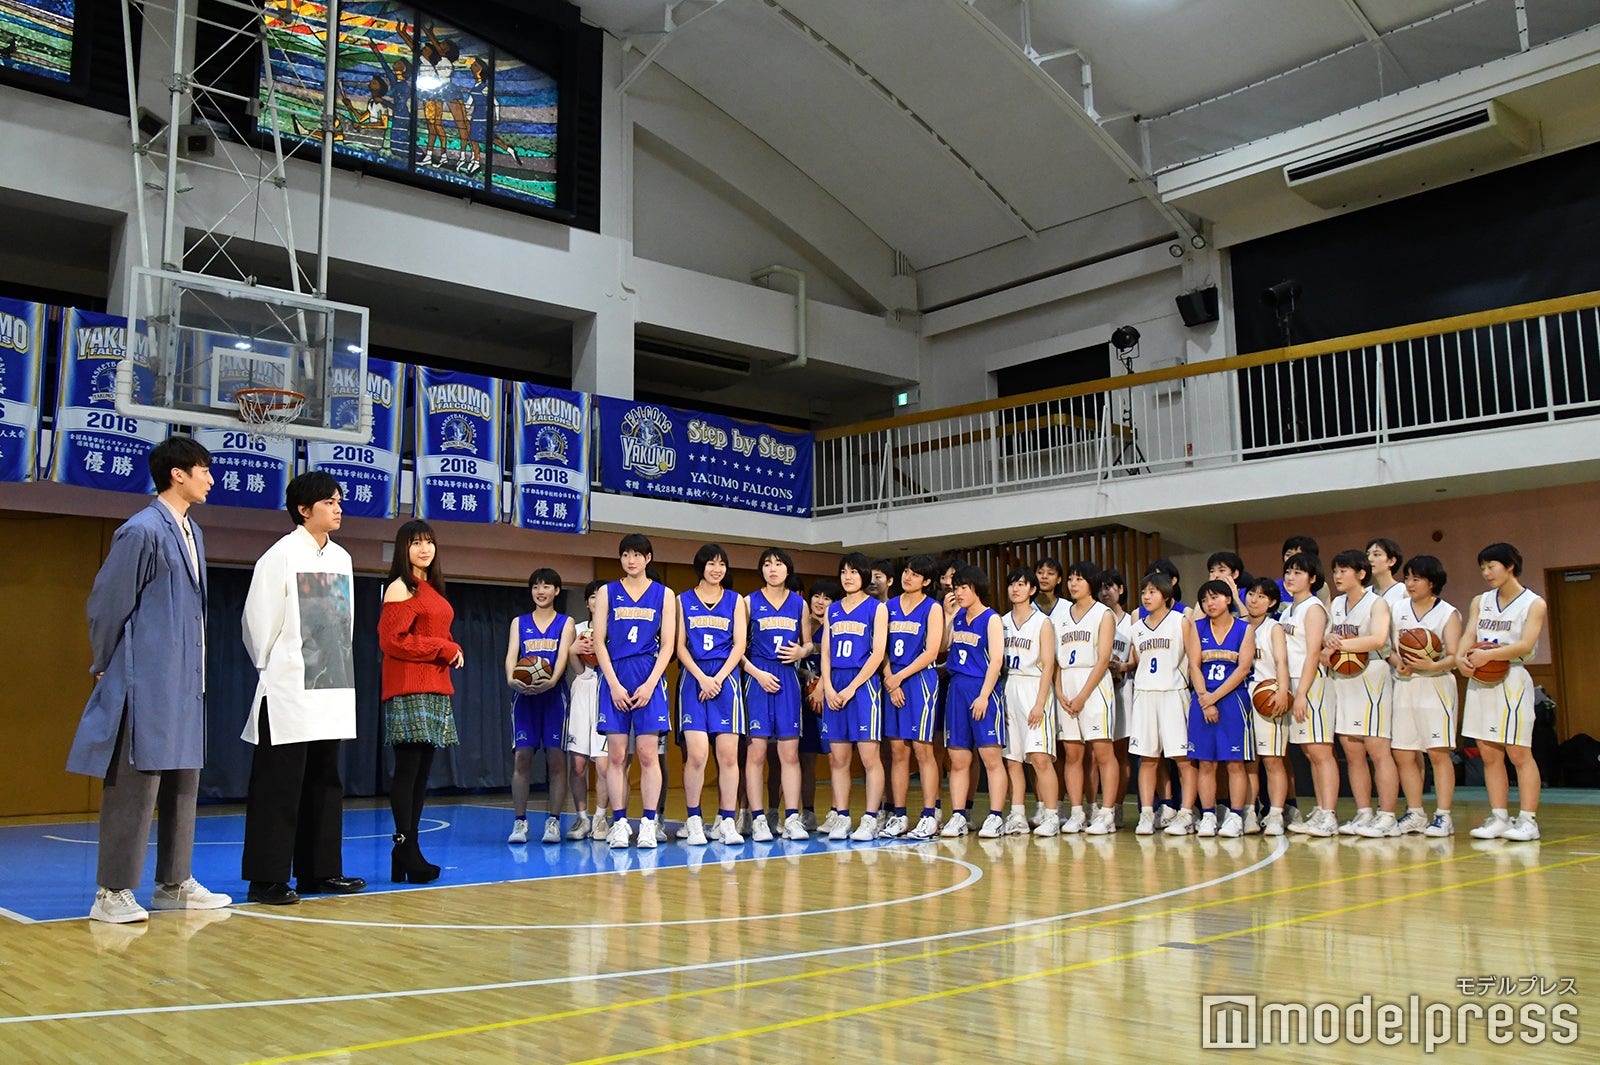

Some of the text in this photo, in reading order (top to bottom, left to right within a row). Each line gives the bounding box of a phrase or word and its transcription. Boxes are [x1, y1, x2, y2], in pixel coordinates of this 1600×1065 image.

[427, 384, 491, 419] YAKUMO
[437, 402, 480, 414] FALCONS
[86, 411, 138, 434] 2016
[524, 397, 581, 431] YAKUMO
[624, 405, 673, 434] FALCONS
[687, 419, 797, 465] Step by Step
[332, 445, 375, 465] 2018
[620, 434, 676, 472] YAKUMO
[82, 450, 135, 477] 優勝
[440, 457, 478, 475] 2018
[221, 470, 267, 494] 優勝
[534, 467, 569, 485] 2018
[742, 481, 794, 500] FALCONS
[440, 491, 479, 512] 優勝
[533, 499, 569, 520] 優勝
[627, 625, 639, 644] 4
[703, 633, 714, 652] 5
[773, 635, 784, 653] 7
[835, 640, 853, 658] 10
[893, 638, 905, 657] 8
[957, 649, 968, 665] 9
[1068, 649, 1077, 665] 8
[1149, 656, 1158, 674] 9
[1207, 664, 1226, 681] 13
